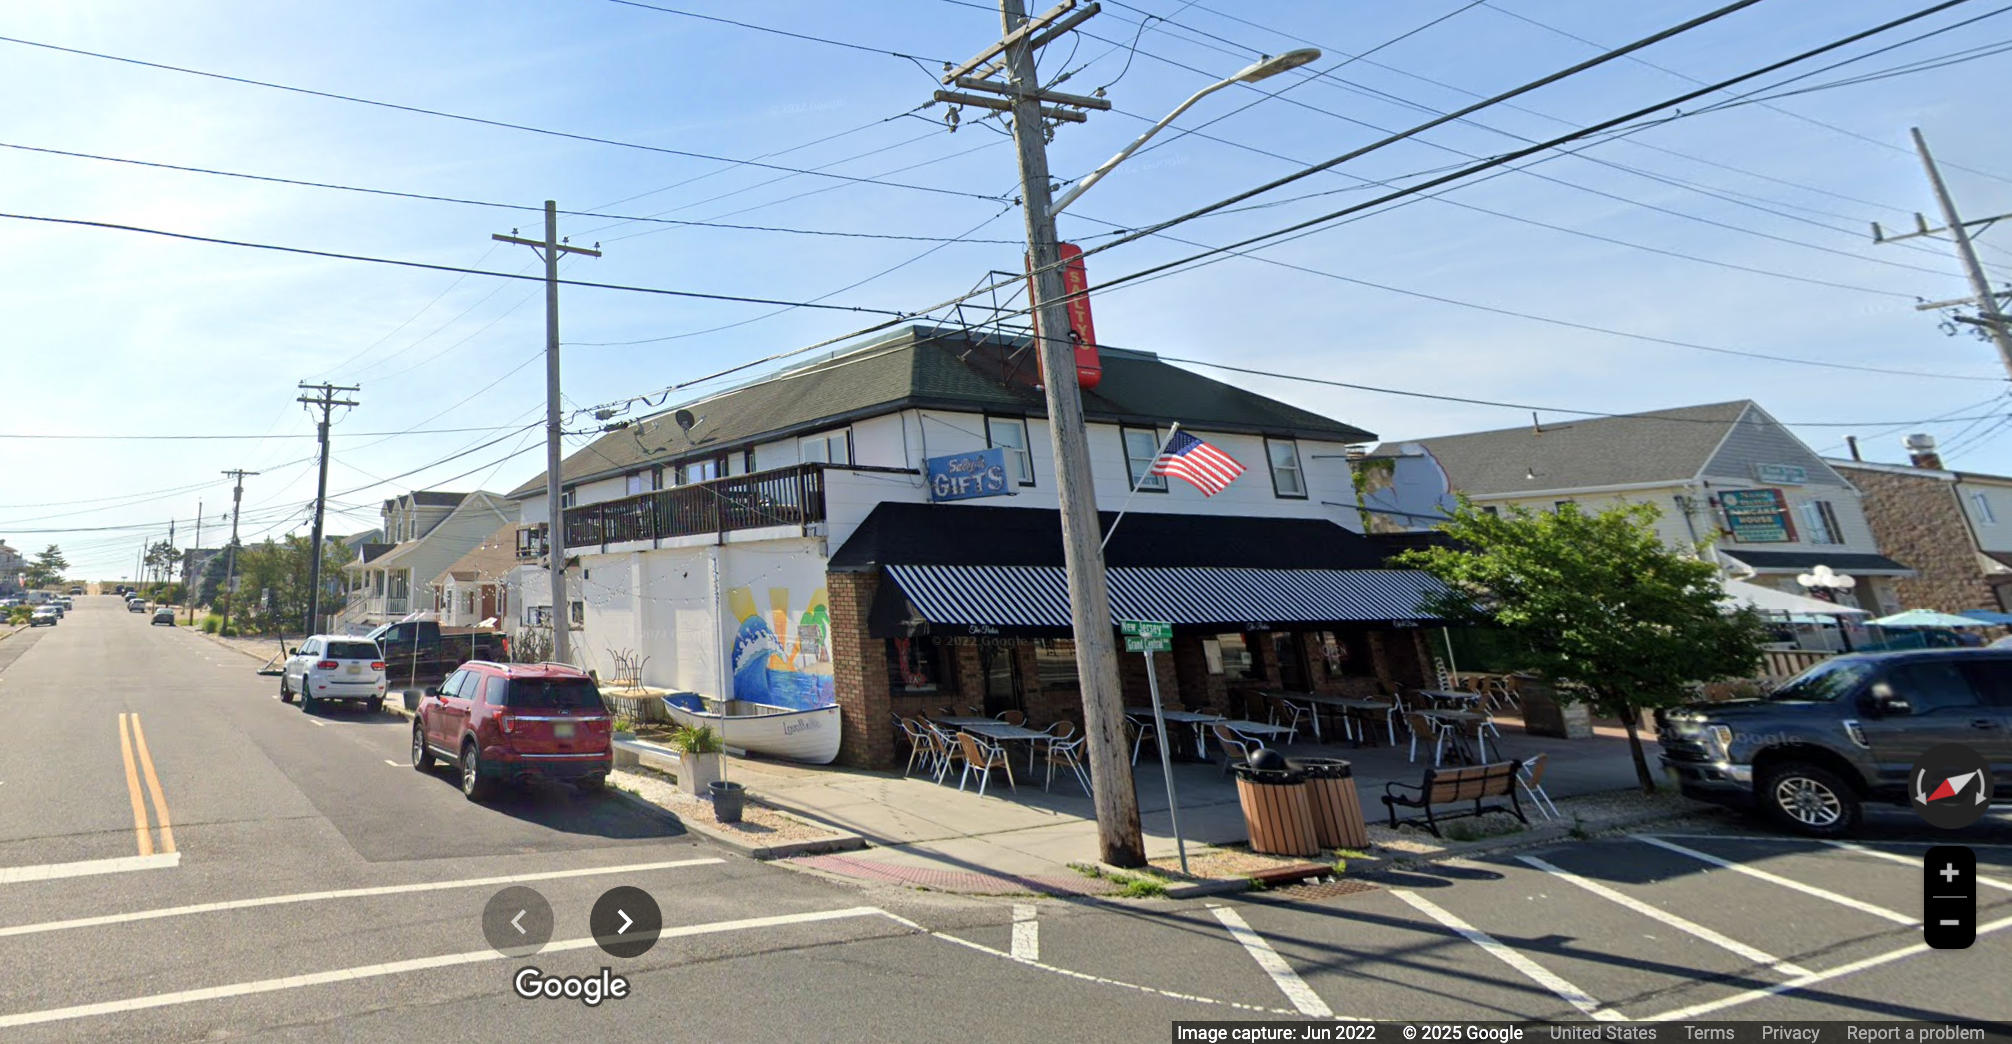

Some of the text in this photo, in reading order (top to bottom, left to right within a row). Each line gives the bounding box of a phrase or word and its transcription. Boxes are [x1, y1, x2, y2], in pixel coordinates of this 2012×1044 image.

[934, 465, 1004, 498] GIFTS
[1121, 621, 1137, 631] New
[1138, 622, 1162, 636] Jersey
[1127, 638, 1144, 650] Grand
[1144, 638, 1164, 649] Central
